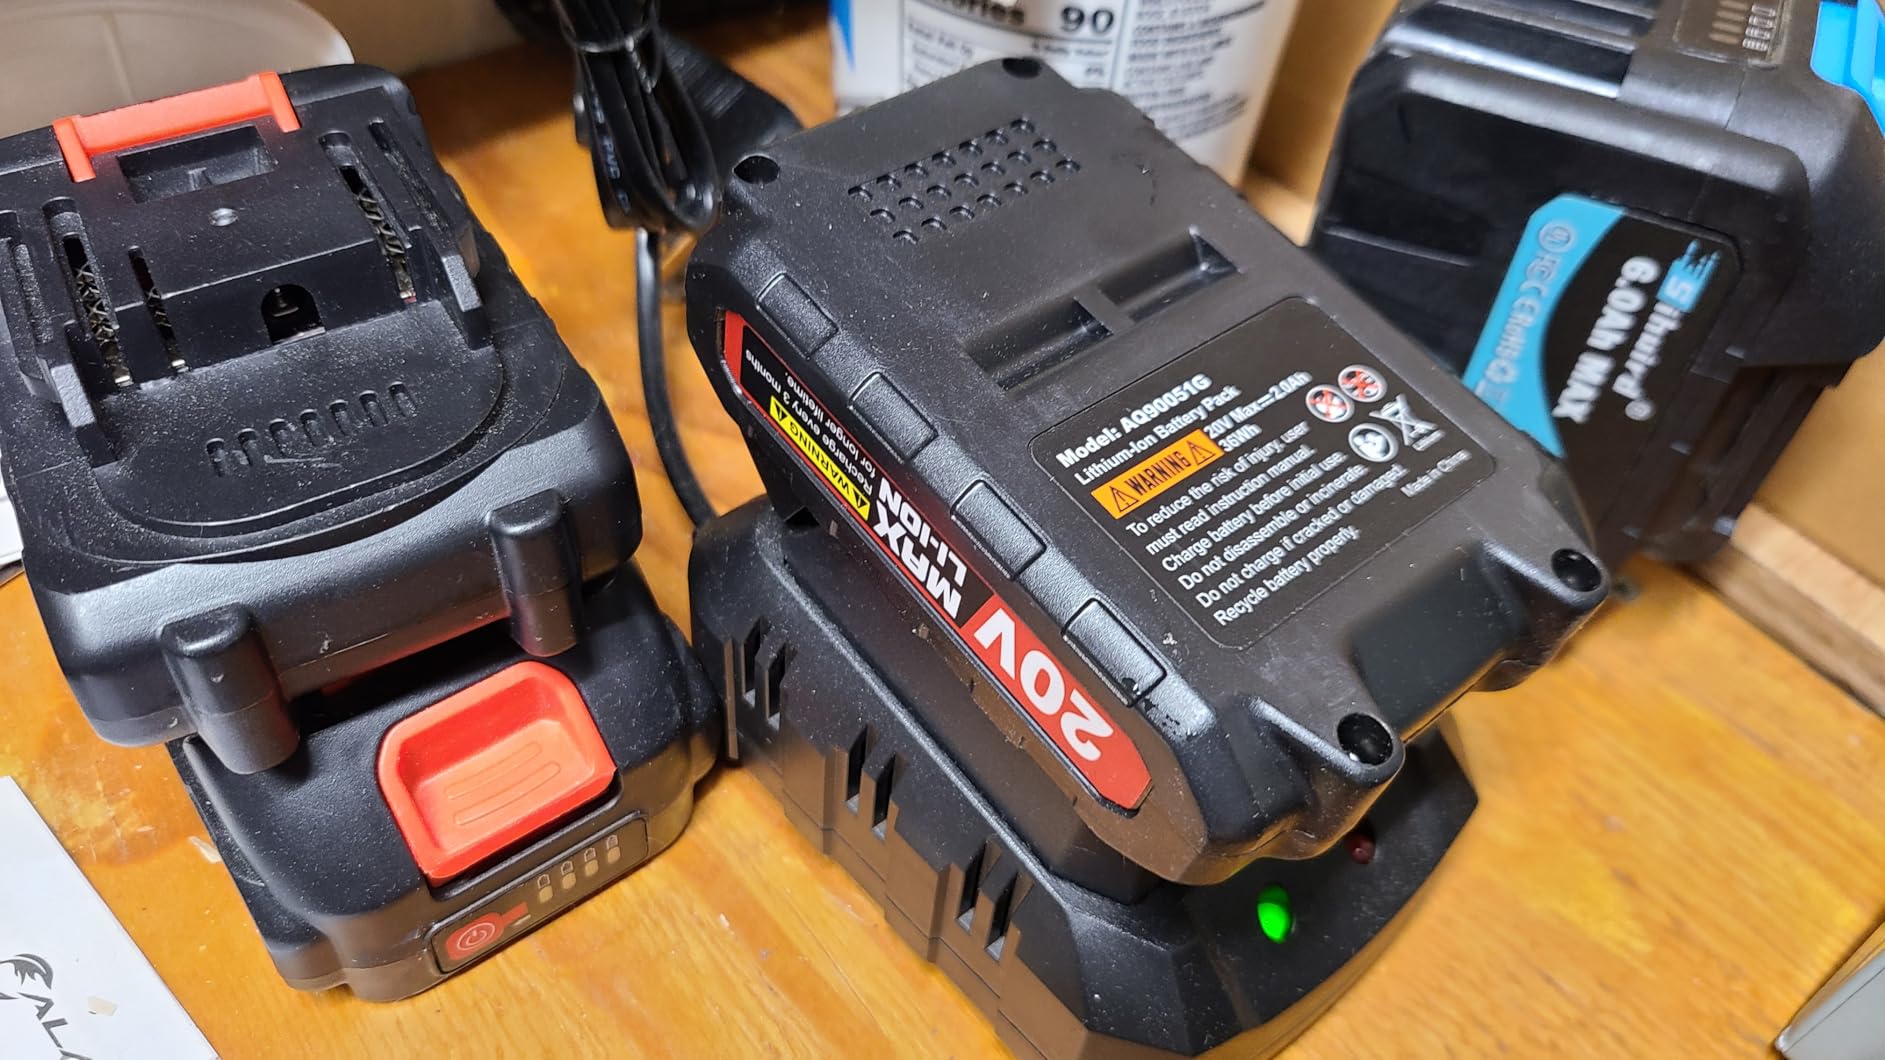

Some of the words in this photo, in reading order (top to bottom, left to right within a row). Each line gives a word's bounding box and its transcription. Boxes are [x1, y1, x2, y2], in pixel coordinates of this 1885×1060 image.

[1061, 6, 1114, 33] 90
[1586, 256, 1661, 351] 6.0Ah
[745, 349, 782, 394] months
[783, 390, 791, 401] 3
[785, 372, 824, 423] lifetime.
[1551, 351, 1615, 423] MAX
[791, 400, 821, 435] every
[825, 418, 860, 462] longer
[1056, 427, 1122, 468] Model:
[1120, 373, 1212, 434] AQ90051G
[1074, 434, 1158, 485] Lithium-Ion
[1153, 405, 1208, 440] Battery
[1201, 385, 1242, 412] Pack
[1203, 414, 1234, 439] 20V
[1218, 424, 1262, 452] 36Wh
[789, 421, 850, 495] WARNING
[822, 434, 873, 495] Recharge
[860, 459, 876, 479] for
[1124, 451, 1192, 496] WARNING
[1125, 521, 1149, 537] To
[1146, 495, 1193, 527] reduce
[1188, 481, 1215, 501] the
[1211, 467, 1239, 487] risk
[1233, 456, 1252, 473] of
[1280, 420, 1310, 444] user
[879, 477, 967, 587] LI-ION
[1145, 527, 1184, 555] must
[1177, 508, 1212, 535] read
[1204, 472, 1273, 516] instruction
[1266, 444, 1318, 479] manual.
[1161, 537, 1213, 572] Charge
[1207, 509, 1257, 543] battery
[1248, 485, 1294, 515] before
[1285, 463, 1324, 492] initial
[1319, 451, 1349, 472] use.
[1178, 571, 1204, 590] Do
[1200, 555, 1227, 577] not
[1223, 509, 1300, 562] disassemble
[1295, 498, 1314, 514] or
[1305, 464, 1370, 505] incinerate.
[1195, 589, 1221, 608] Do
[1218, 572, 1246, 594] not
[1241, 546, 1287, 579] charge
[1279, 536, 1297, 551] if
[1292, 506, 1342, 544] cracked
[1336, 498, 1357, 514] or
[1350, 463, 1410, 505] damaged.
[873, 500, 962, 619] MAX
[1213, 587, 1269, 626] Recycle
[1263, 557, 1313, 592] battery
[1306, 525, 1361, 566] properly.
[973, 607, 1114, 762] 20V
